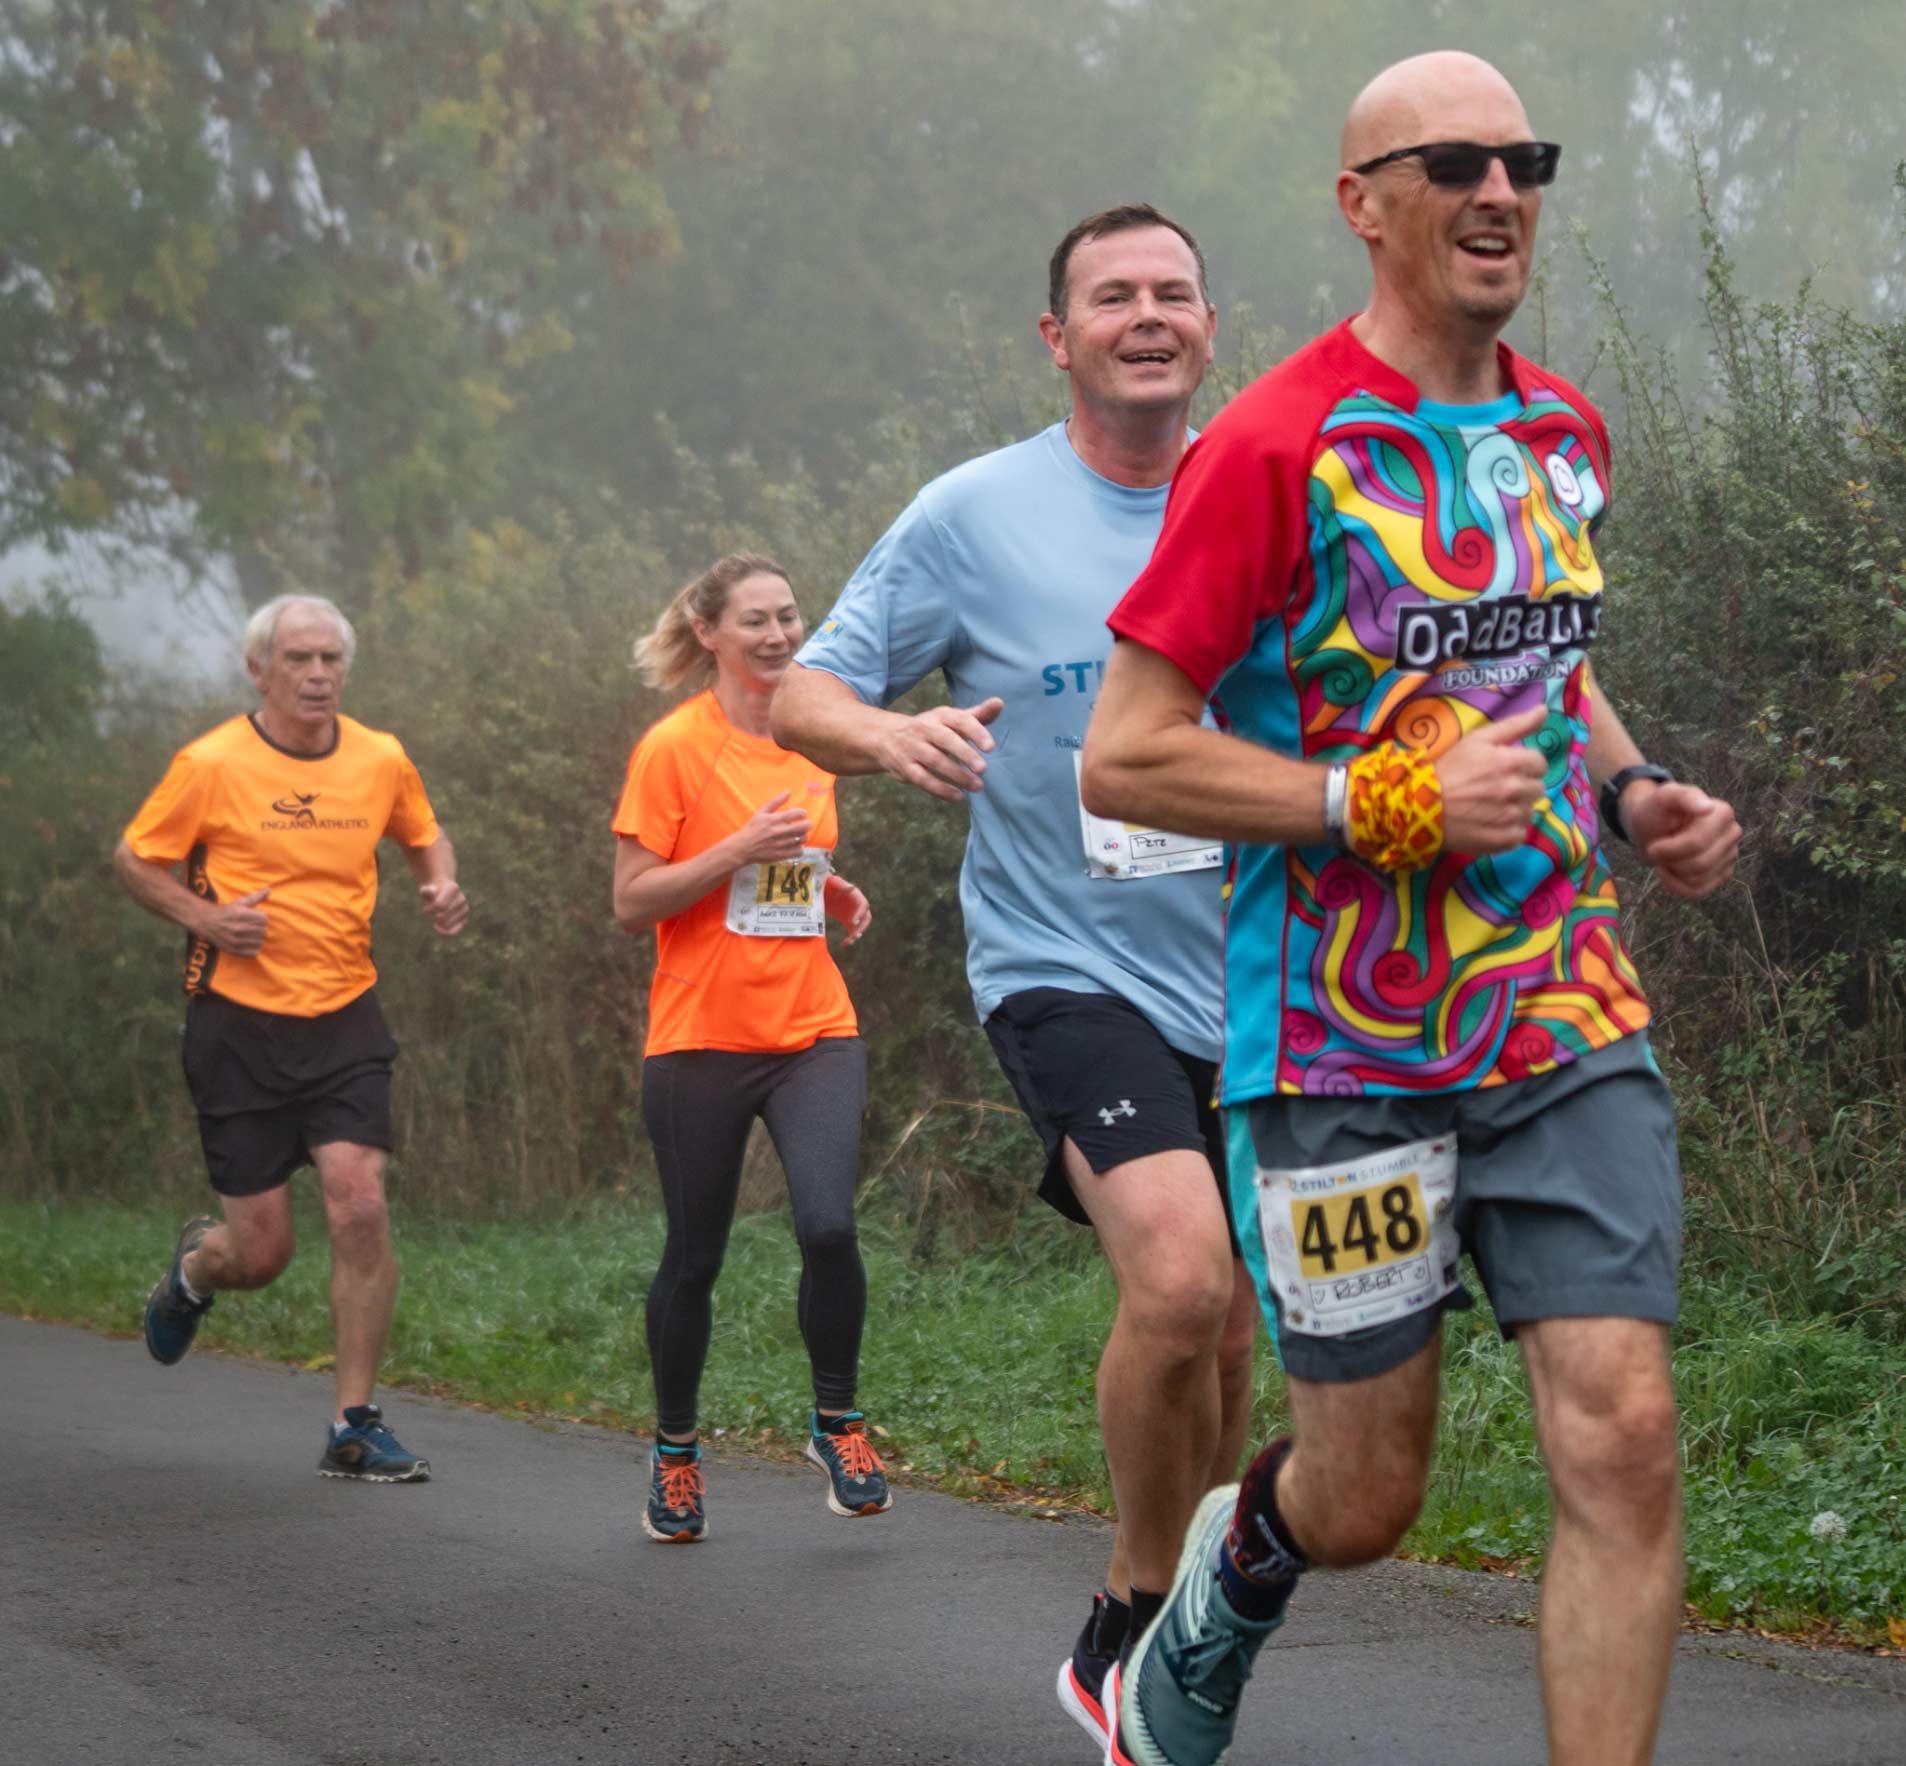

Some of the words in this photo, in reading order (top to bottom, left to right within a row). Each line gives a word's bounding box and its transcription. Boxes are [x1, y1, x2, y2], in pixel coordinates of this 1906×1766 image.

[1444, 660, 1570, 689] FOUNDATION
[261, 820, 314, 830] ENGLAND
[318, 818, 368, 829] ATHLETICS
[765, 863, 811, 903] 148
[1361, 1154, 1420, 1180] STUMBLE
[1302, 1185, 1421, 1273] 448
[1334, 1263, 1412, 1300] ROBERT
